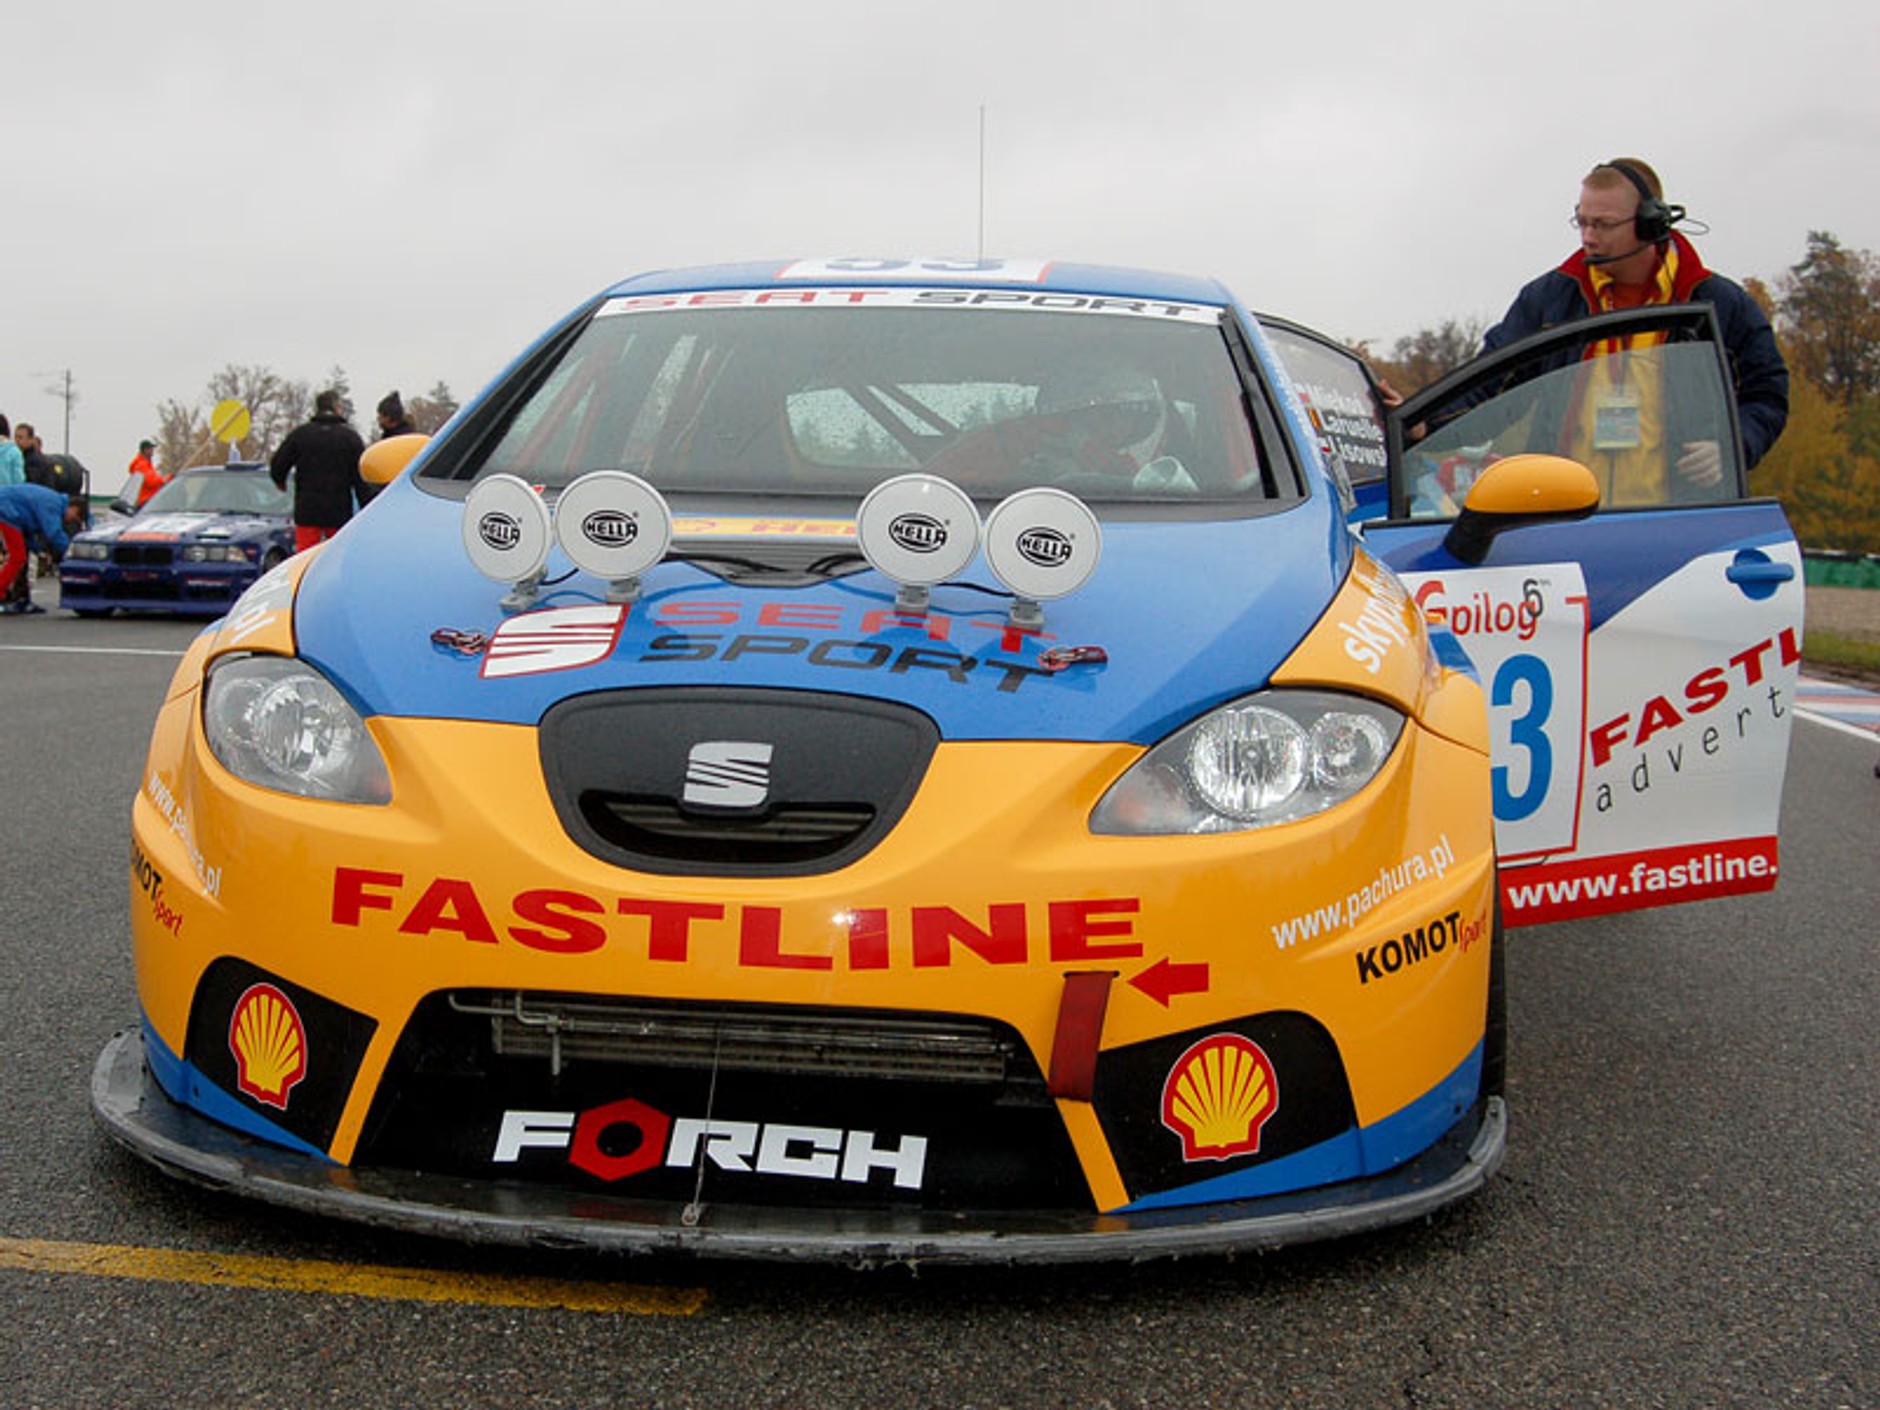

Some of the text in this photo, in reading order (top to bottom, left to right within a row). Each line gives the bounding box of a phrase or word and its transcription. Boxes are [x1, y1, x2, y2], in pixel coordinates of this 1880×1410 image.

[621, 290, 1199, 316] SEAT SPORT
[480, 517, 521, 547] HELLA
[582, 517, 638, 543] HELLA
[889, 518, 947, 549] HELLA
[1018, 532, 1072, 563] HELLA
[654, 601, 1057, 652] SEAT
[639, 633, 1055, 692] SPORT
[1597, 686, 1785, 812] advert
[1272, 832, 1455, 949] www.pachura.pl
[1507, 853, 1777, 909] www.fastline.
[332, 866, 1144, 971] FASTLINE
